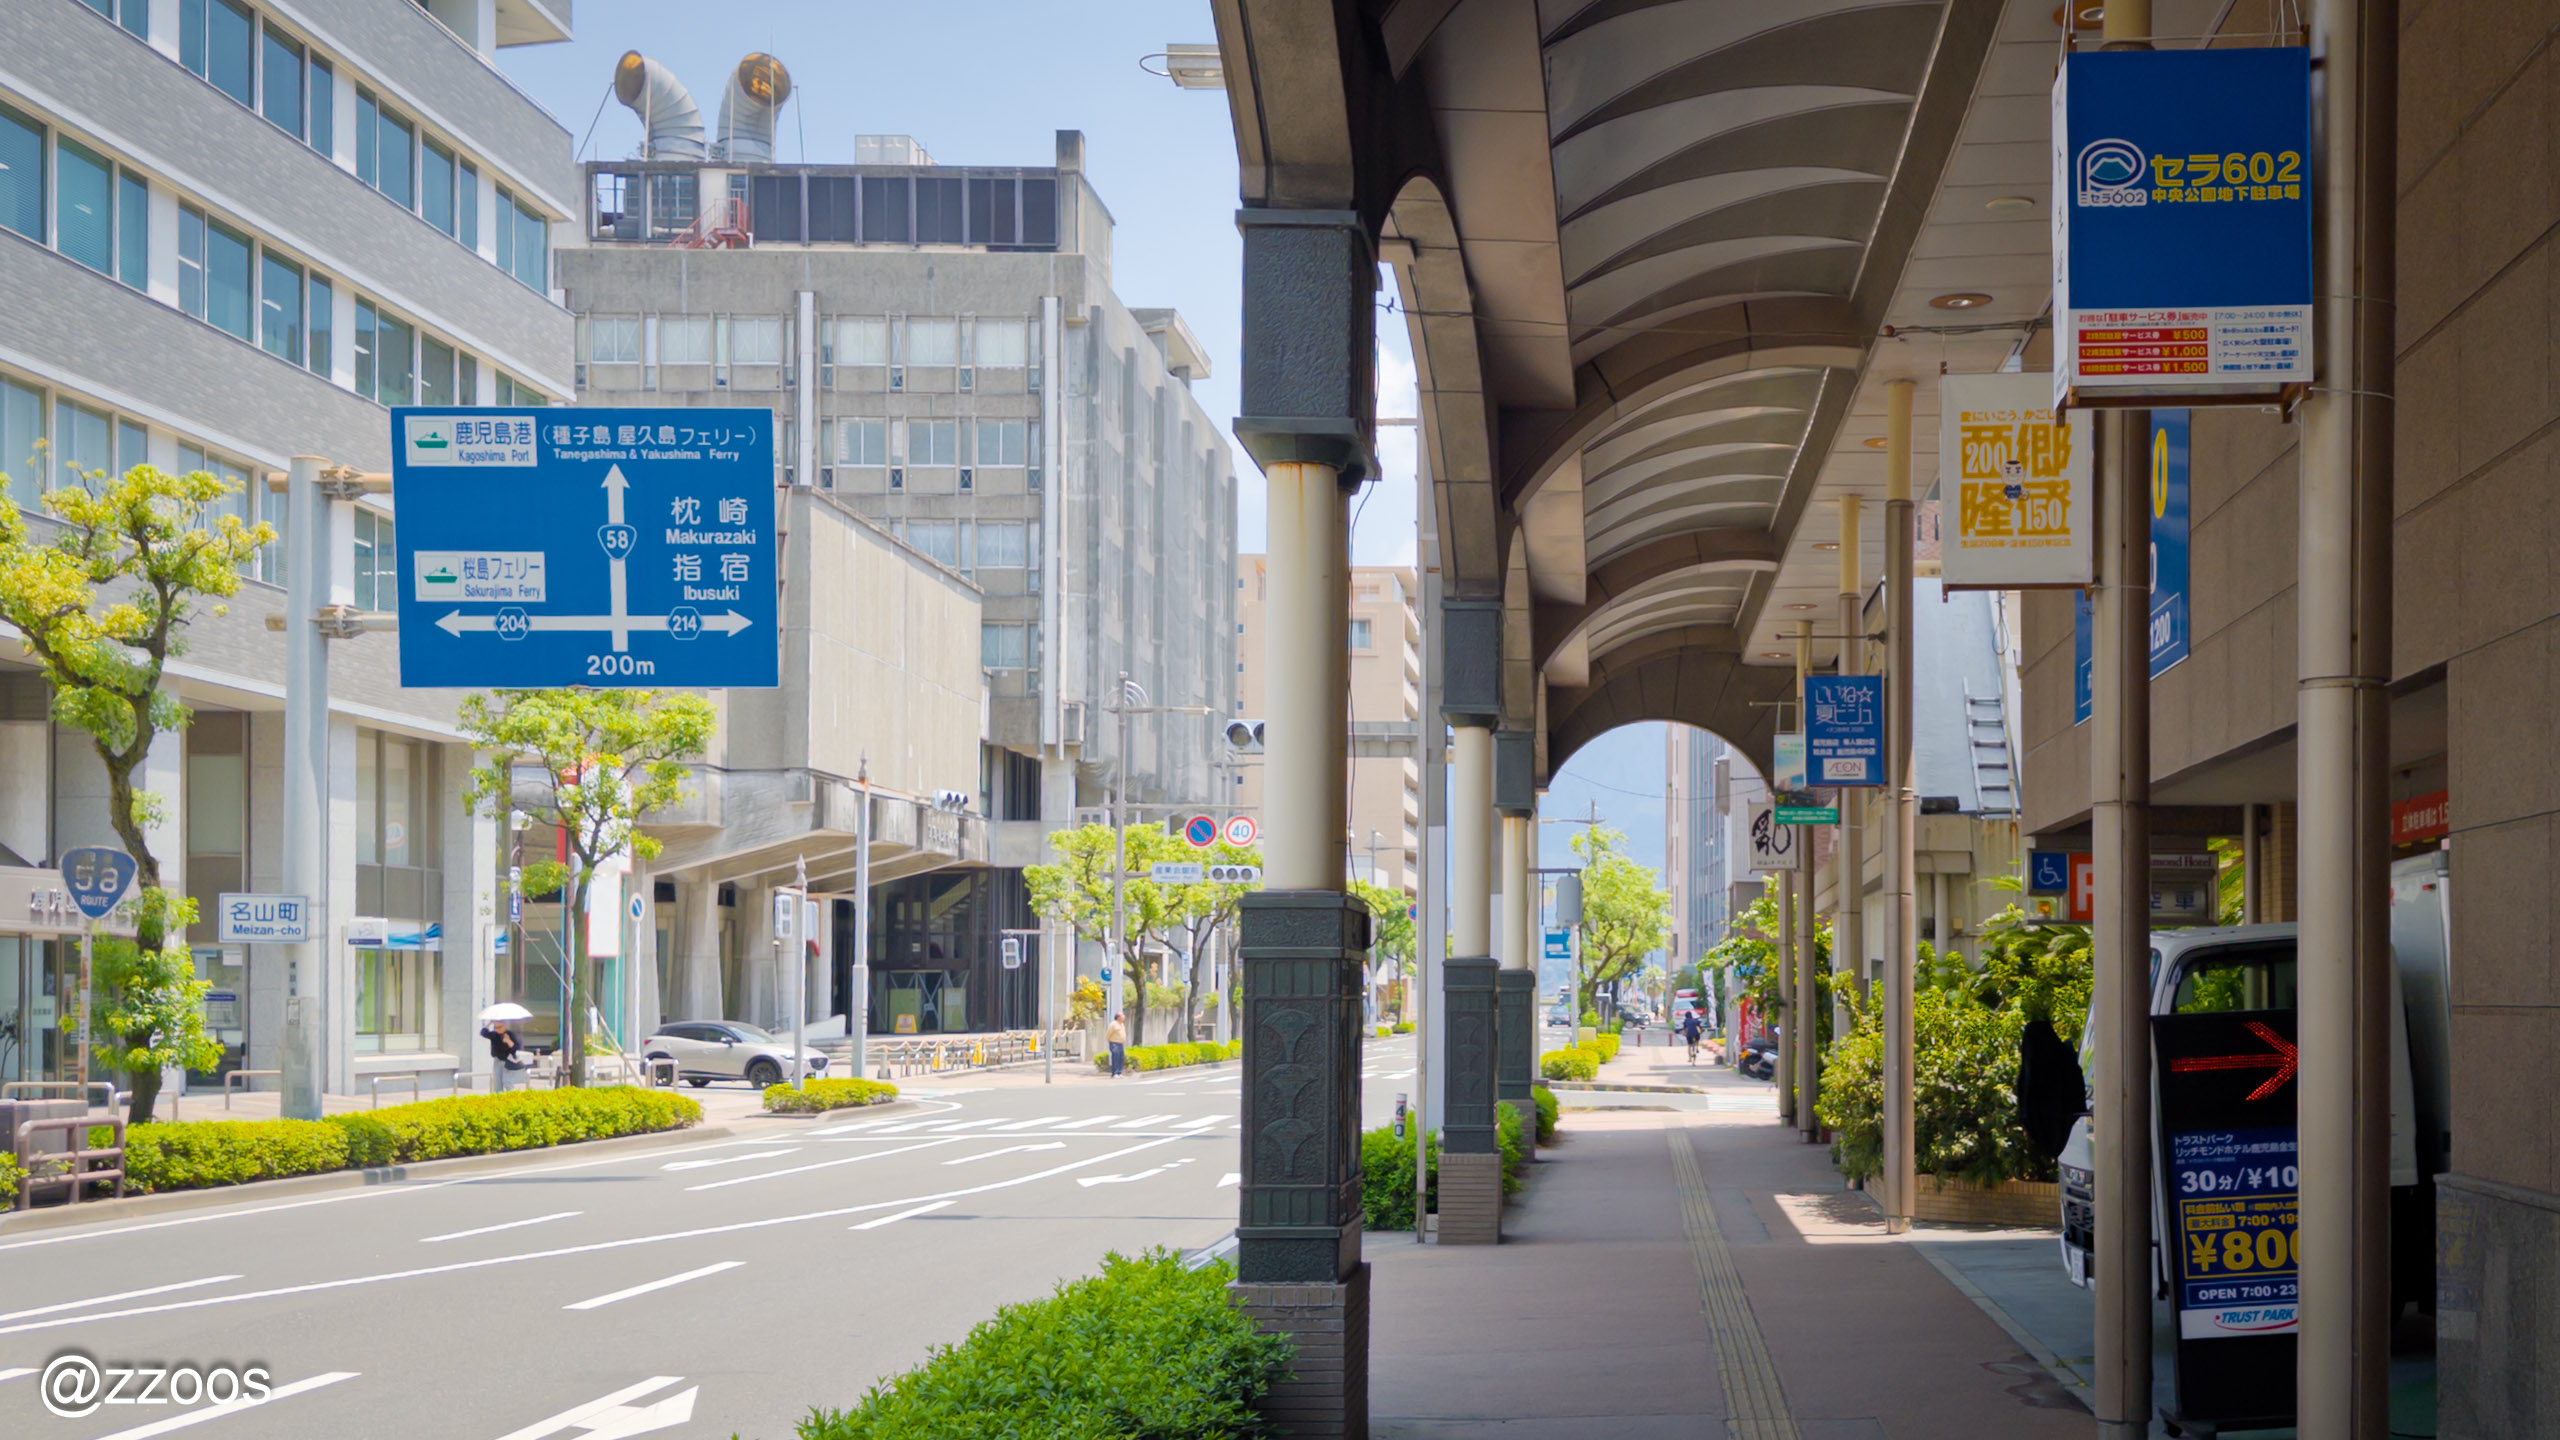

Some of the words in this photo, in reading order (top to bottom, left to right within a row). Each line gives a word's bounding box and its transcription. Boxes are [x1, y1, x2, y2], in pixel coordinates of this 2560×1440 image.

[2150, 151, 2301, 187] セラ602
[2151, 184, 2301, 203] 中央公園地下駐車場
[455, 421, 532, 446] 鹿児島港
[458, 449, 506, 463] Kagoshima
[511, 449, 530, 463] Port
[553, 448, 627, 462] Tanegashima
[629, 449, 638, 460] &
[641, 448, 701, 460] Yakushima
[709, 448, 740, 462] Ferry
[2025, 498, 2063, 530] 150
[606, 530, 629, 549] 58
[665, 529, 757, 545] Makurazaki
[463, 557, 541, 580] 桜島フェリー
[464, 584, 512, 599] Sakurajima
[518, 584, 541, 599] Ferry
[683, 585, 740, 601] Ibusuki
[499, 615, 527, 632] 204
[672, 614, 698, 632] 214
[587, 655, 656, 676] 200m
[1232, 825, 1250, 838] 40
[2184, 855, 2212, 867] Hotel
[74, 864, 119, 893] 58
[80, 894, 110, 908] ROUTE
[230, 902, 299, 923] 名山町
[232, 924, 302, 937] Meizan-cho
[2174, 1134, 2234, 1146] トラストパーク
[2198, 1288, 2237, 1300] OPEN
[2241, 1286, 2271, 1298] 7:00
[2221, 1311, 2260, 1323] TRUST
[2262, 1308, 2295, 1321] PARK
